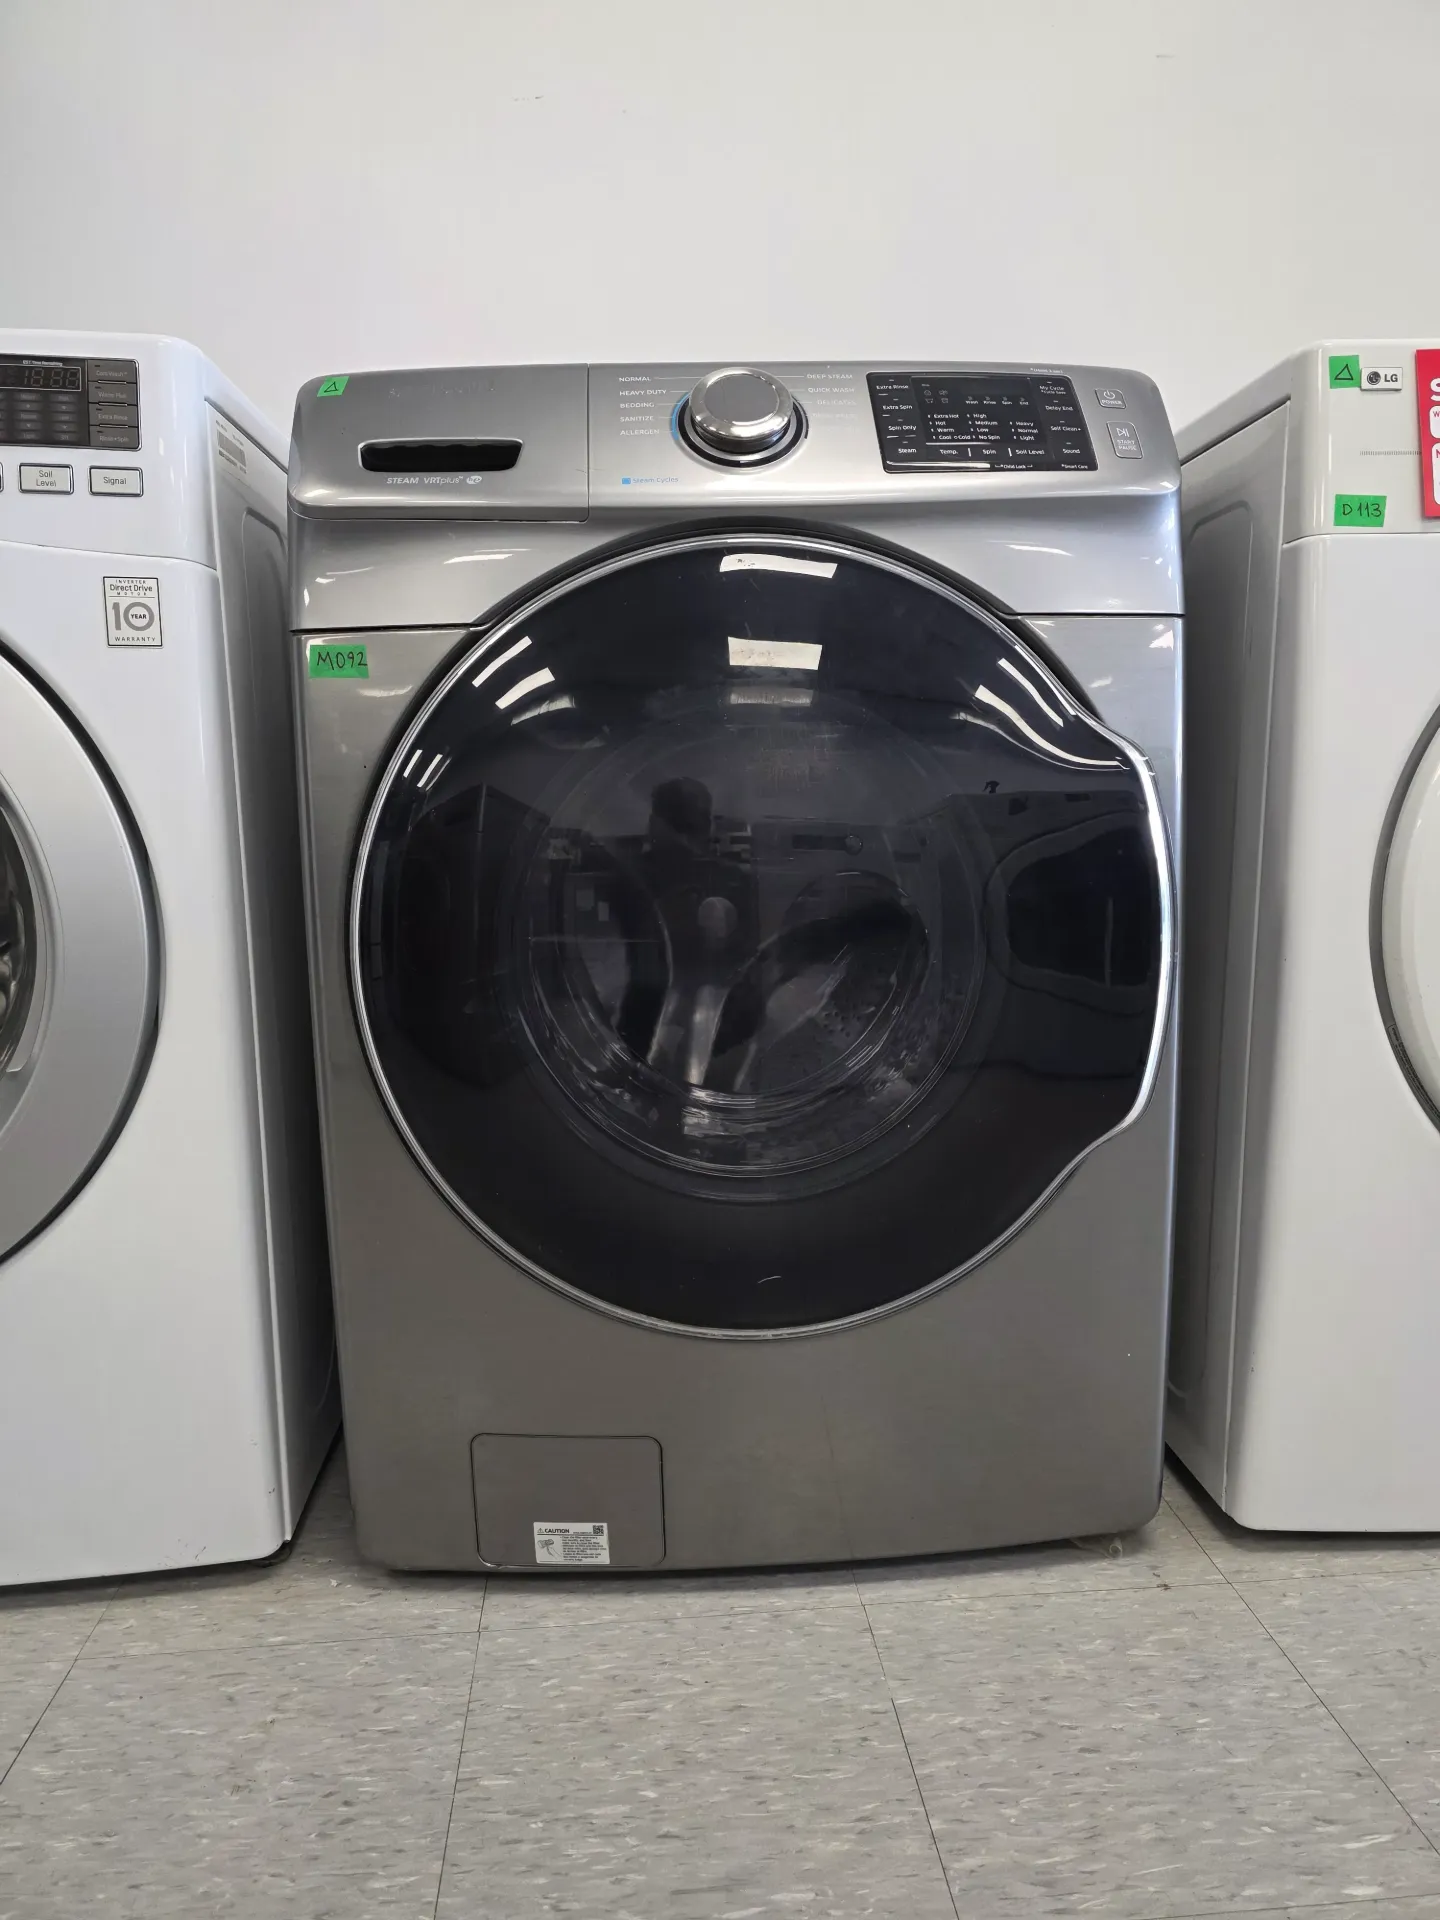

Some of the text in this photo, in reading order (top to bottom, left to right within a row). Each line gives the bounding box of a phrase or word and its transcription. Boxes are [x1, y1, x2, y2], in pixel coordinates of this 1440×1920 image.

[1384, 374, 1398, 382] LG
[38, 470, 53, 478] Soil
[36, 479, 57, 487] Level
[103, 476, 127, 486] Signal
[109, 584, 132, 592] Direct
[112, 601, 155, 631] 10
[317, 651, 368, 671] M092
